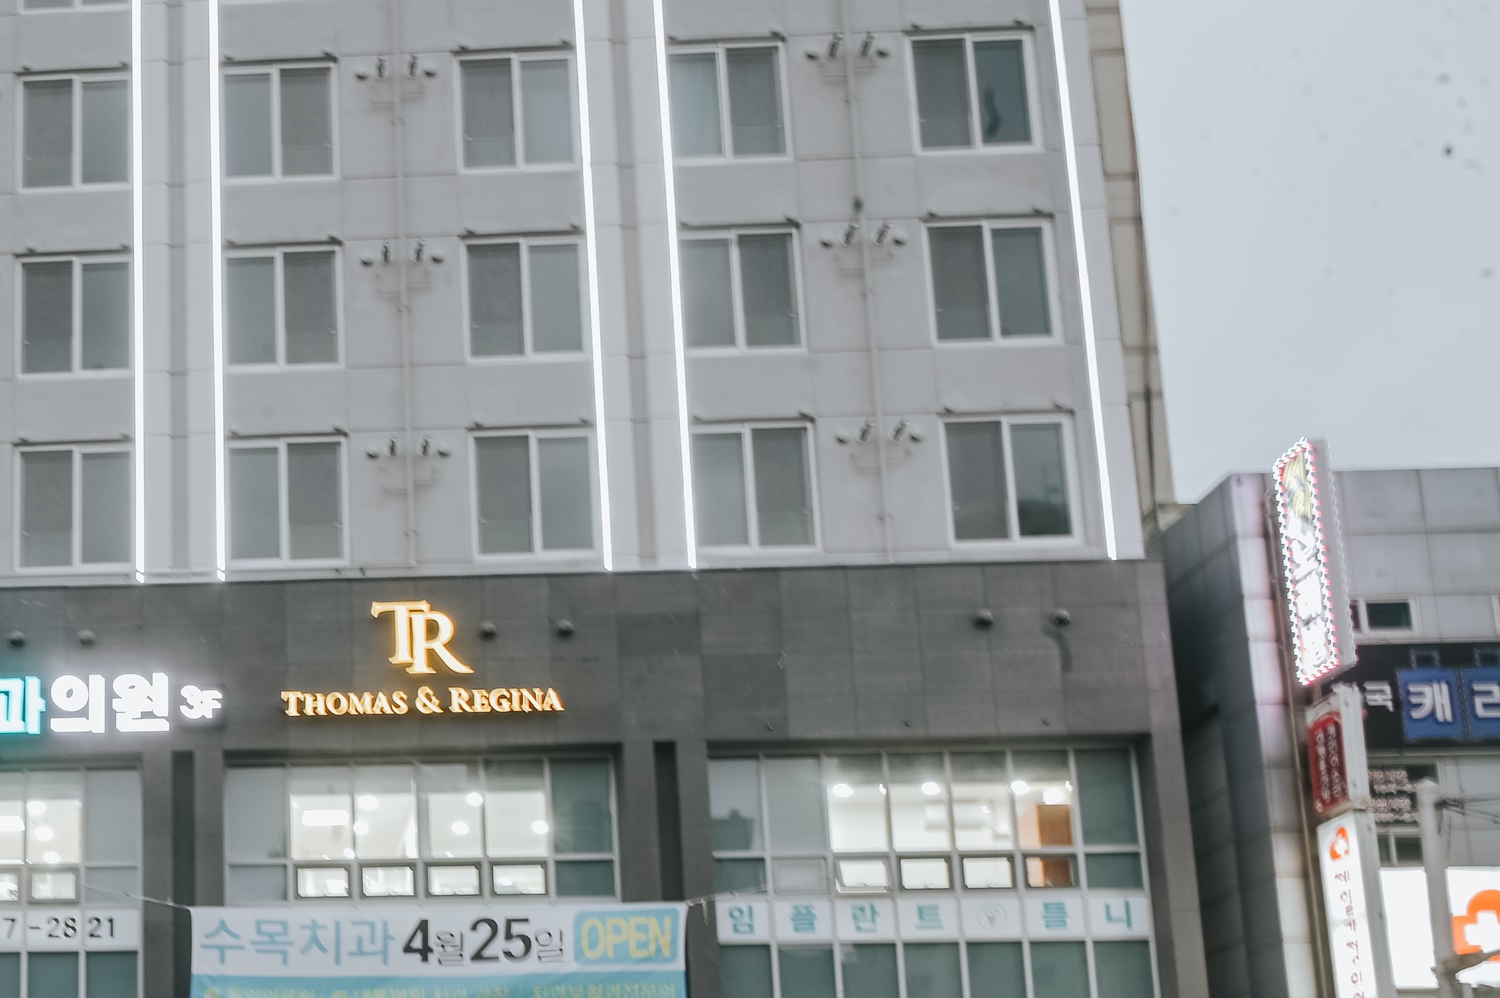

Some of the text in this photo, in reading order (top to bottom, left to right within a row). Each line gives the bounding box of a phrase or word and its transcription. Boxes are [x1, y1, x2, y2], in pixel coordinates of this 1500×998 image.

[180, 684, 223, 720] 3F
[280, 686, 565, 717] THOMAS & REGINA
[200, 917, 397, 967] 수목치과
[581, 914, 672, 960] OPEN
